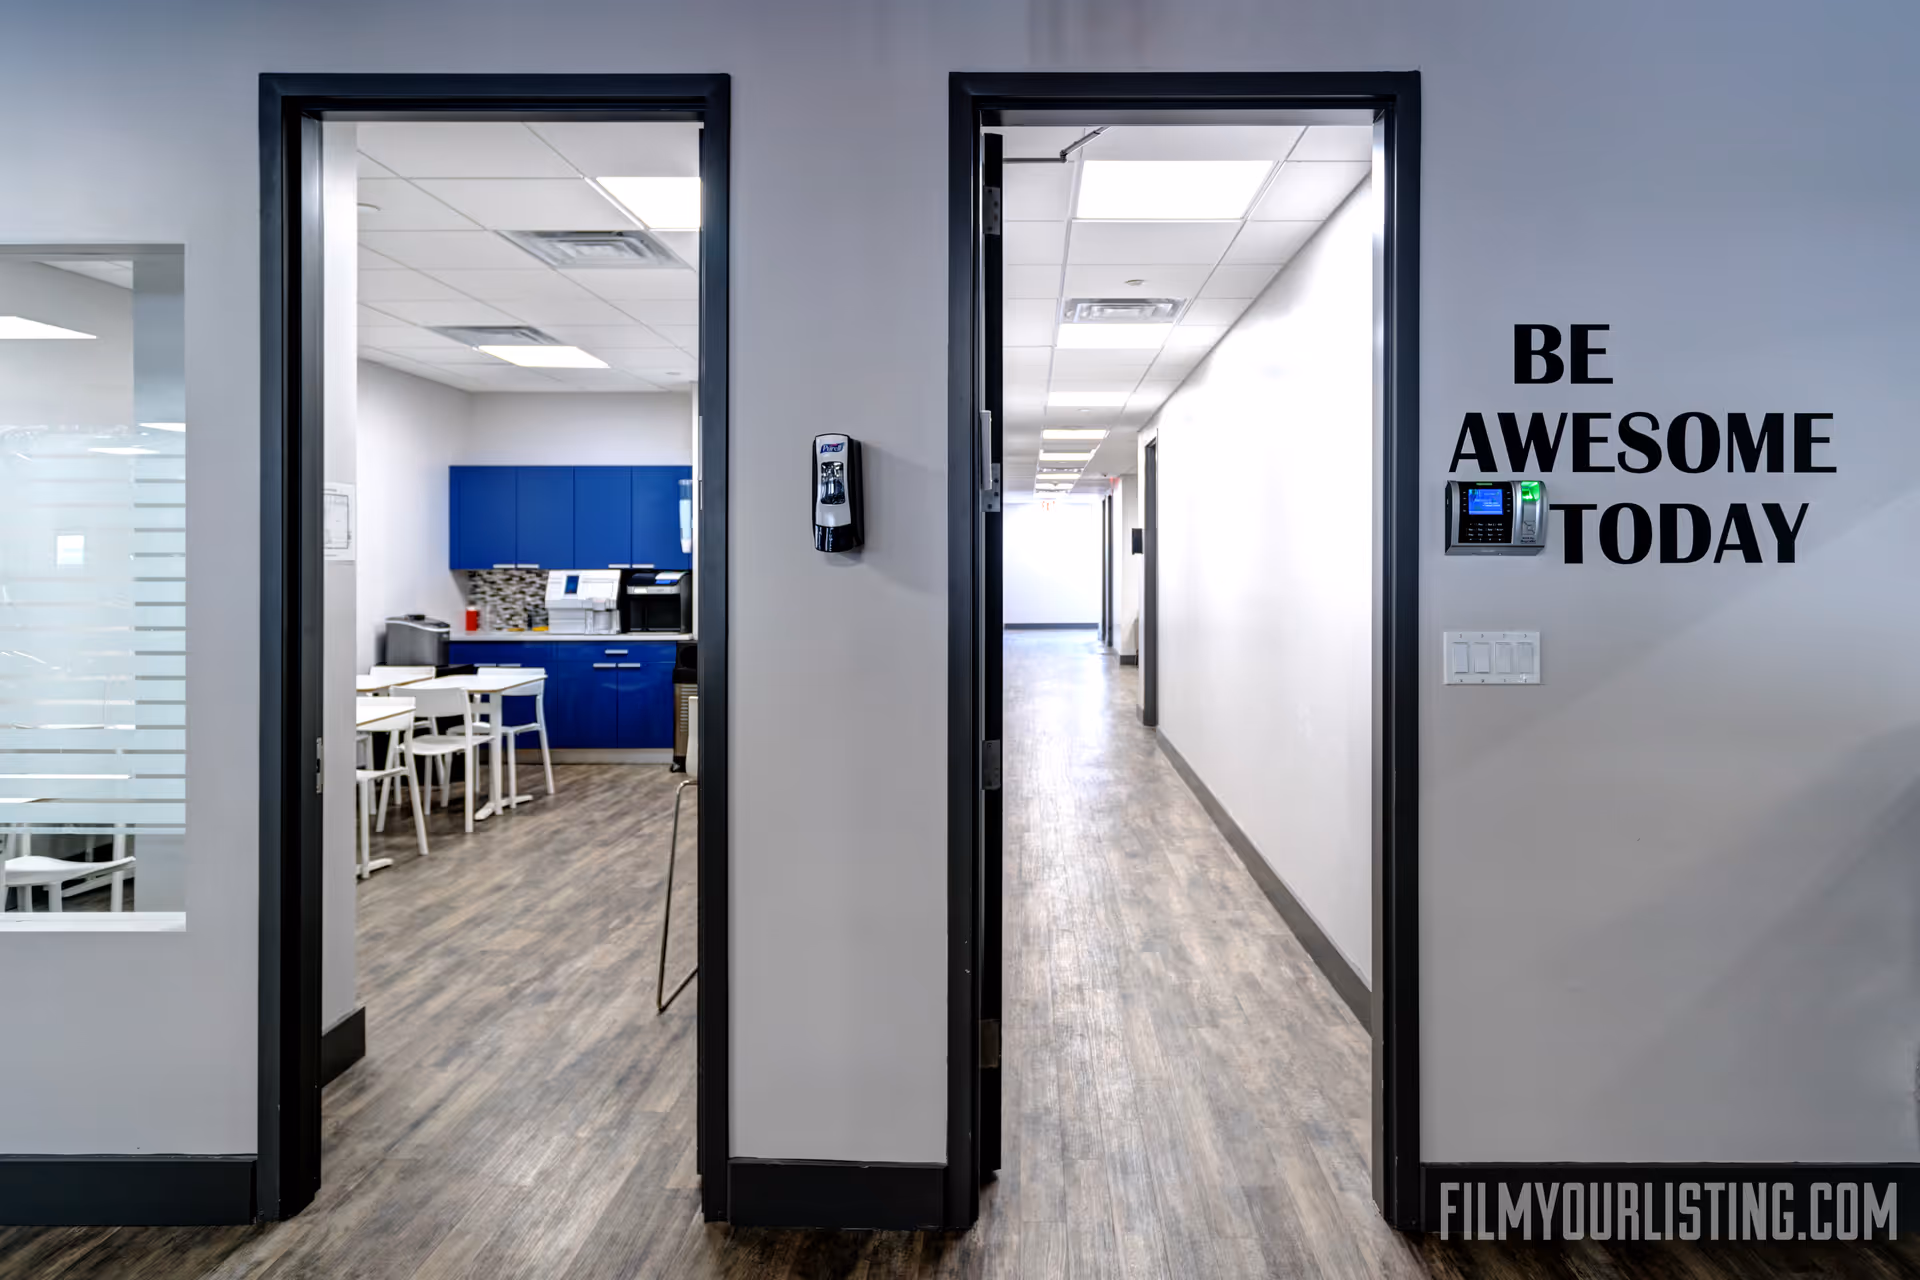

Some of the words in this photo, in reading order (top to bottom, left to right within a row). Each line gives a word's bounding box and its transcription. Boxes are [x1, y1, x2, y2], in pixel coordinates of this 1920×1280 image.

[1514, 323, 1614, 385] BE
[1448, 411, 1838, 474] AWESOME
[1548, 502, 1810, 565] TODAY
